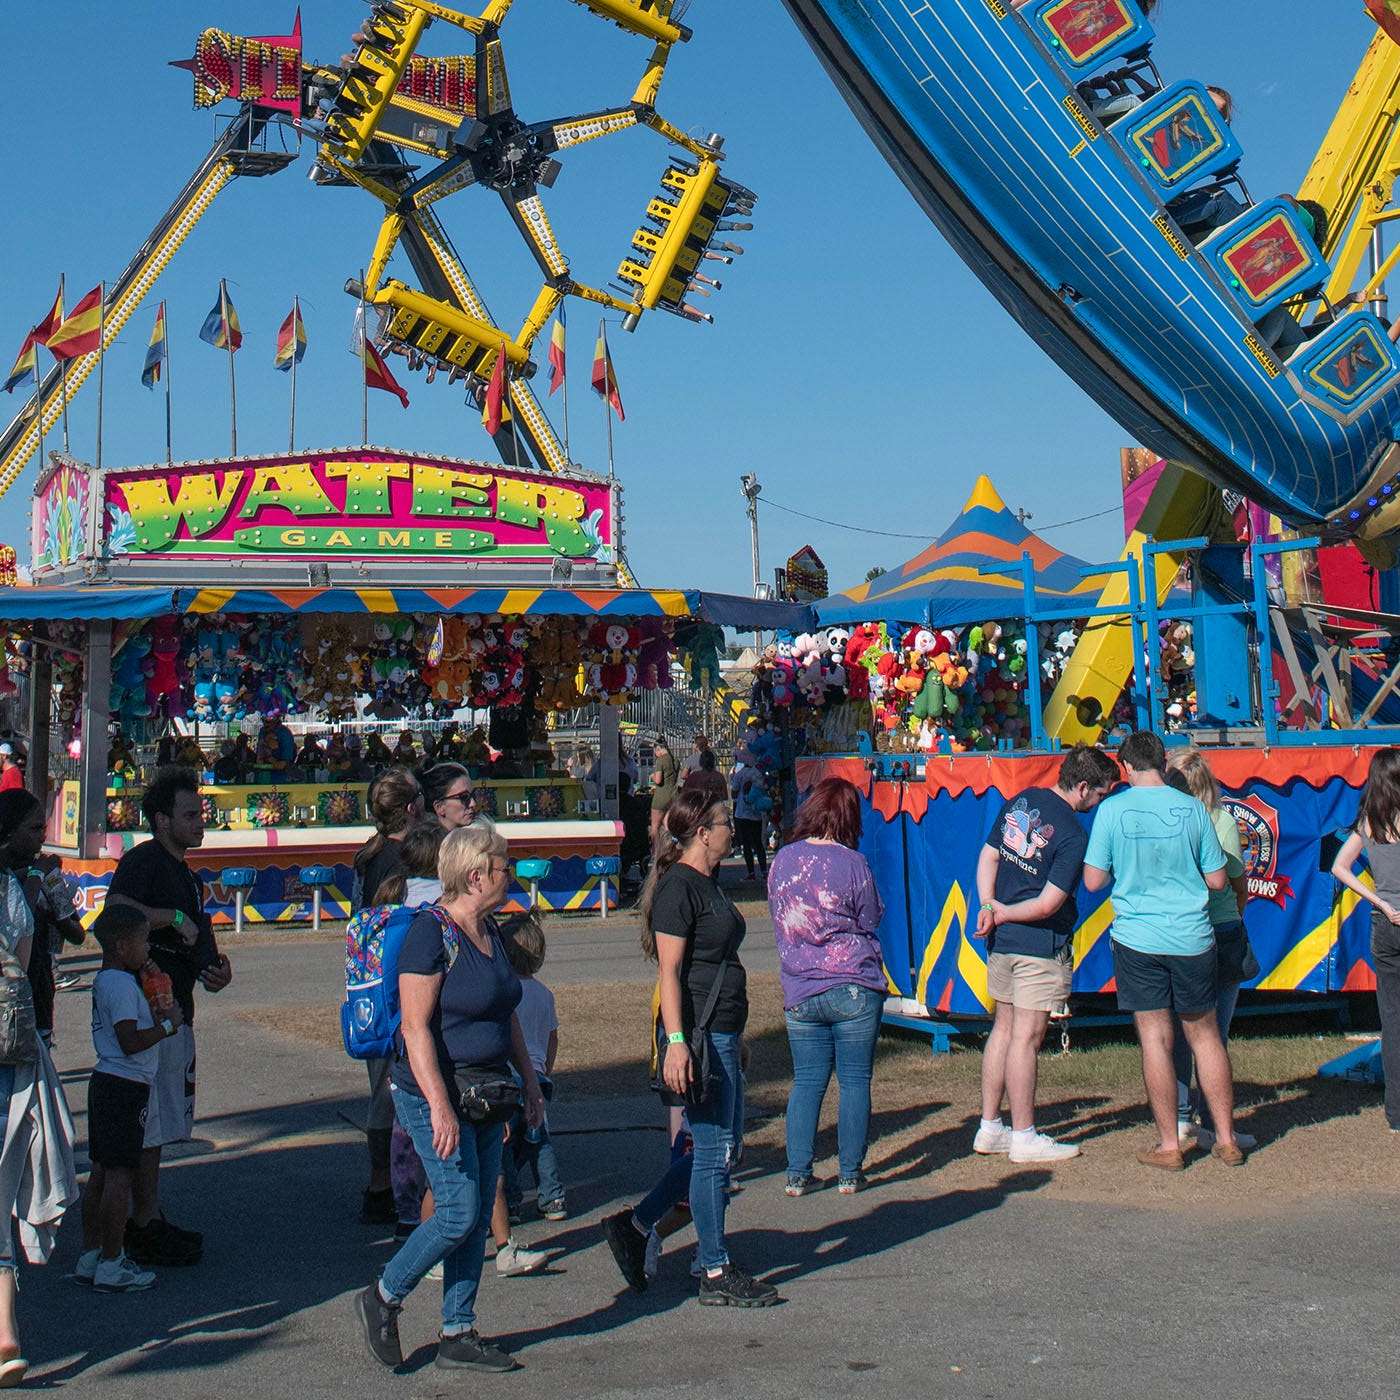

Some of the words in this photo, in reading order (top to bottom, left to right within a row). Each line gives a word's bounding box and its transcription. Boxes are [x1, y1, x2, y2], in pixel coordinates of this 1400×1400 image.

[1067, 97, 1099, 137] CAUTION
[1157, 217, 1189, 257] CAUTION
[1248, 335, 1280, 375] CAUTION
[121, 461, 588, 556] WATER
[280, 529, 453, 547] GAME
[1233, 805, 1258, 825] SHOW
[1255, 821, 1271, 862] BUSINESS
